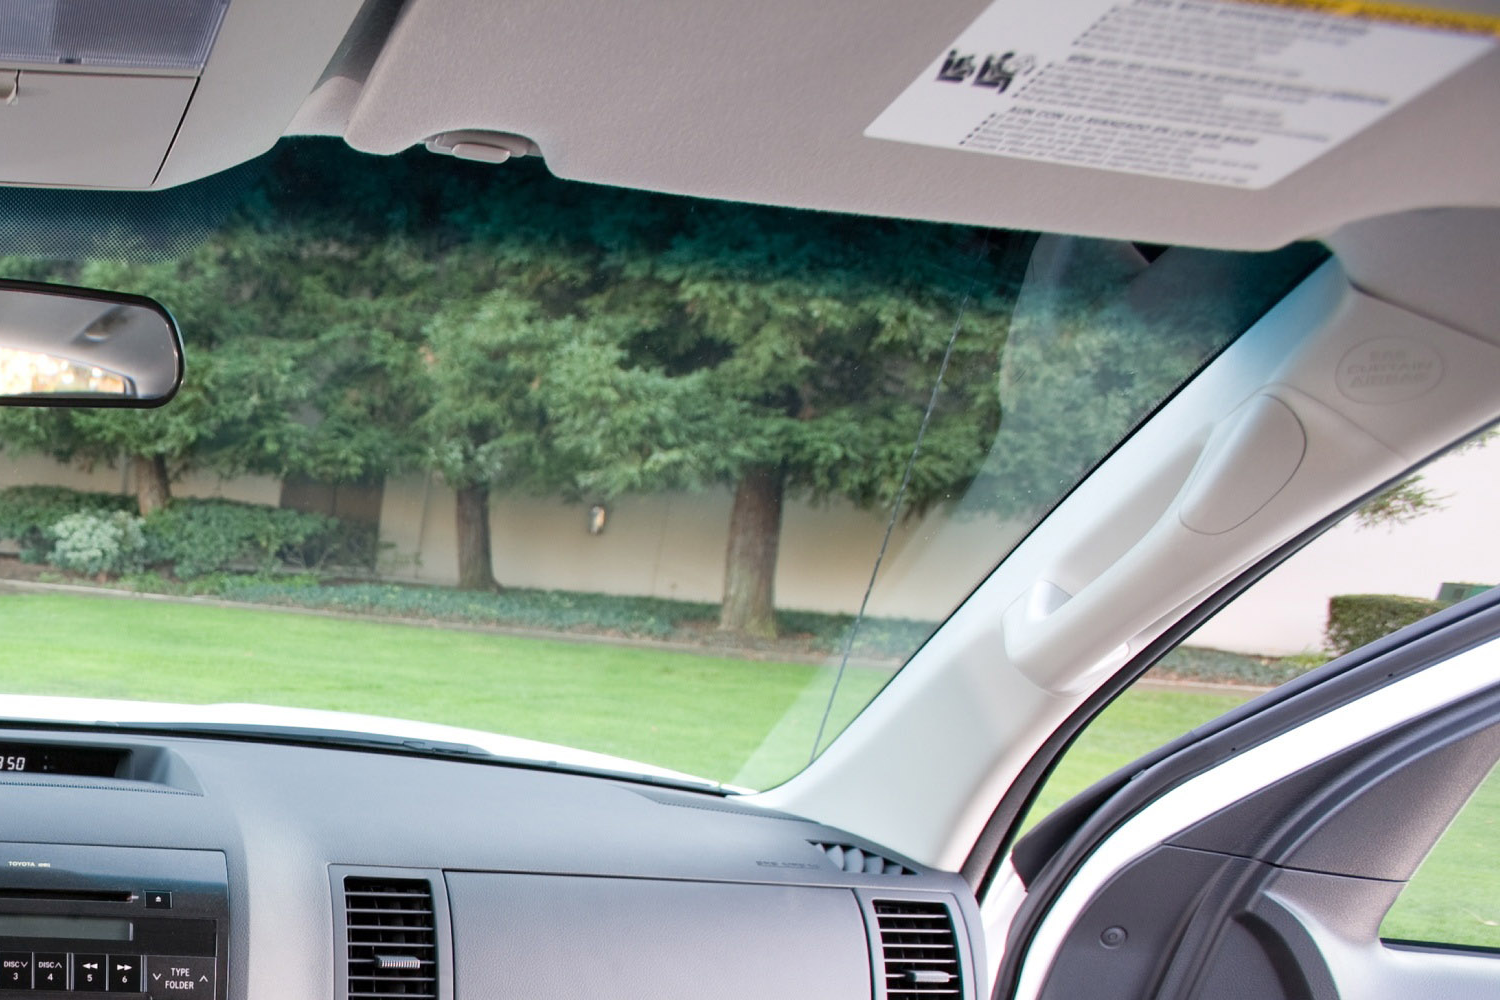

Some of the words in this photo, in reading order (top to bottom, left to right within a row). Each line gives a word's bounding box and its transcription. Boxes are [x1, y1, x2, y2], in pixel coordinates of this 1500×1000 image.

[13, 972, 19, 980] 3
[171, 967, 190, 977] TYPE
[47, 973, 53, 981] 4
[87, 974, 93, 982] 5
[122, 975, 128, 983] 6
[165, 980, 194, 990] FOLDER
